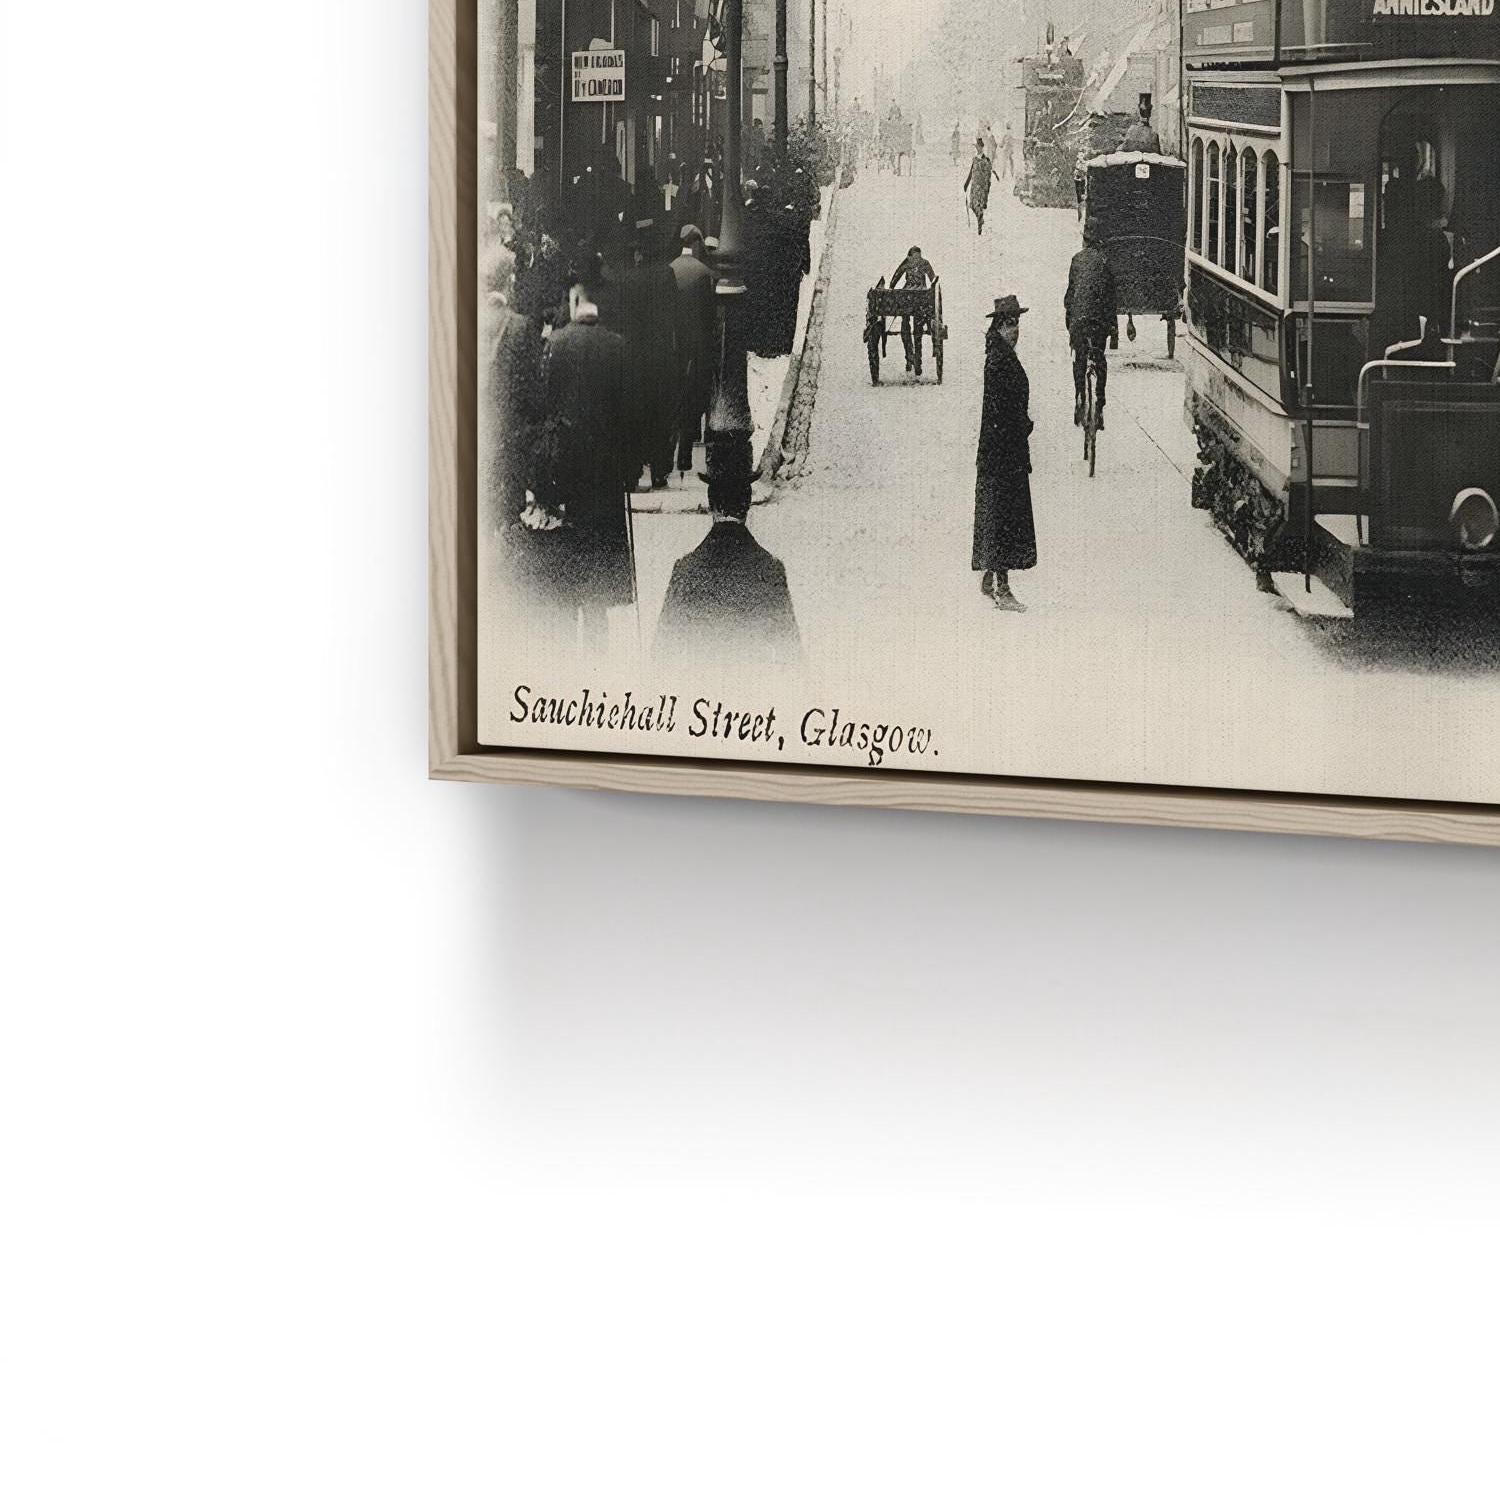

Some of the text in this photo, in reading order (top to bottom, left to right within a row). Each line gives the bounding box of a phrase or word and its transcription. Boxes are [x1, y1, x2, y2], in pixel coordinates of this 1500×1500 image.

[510, 685, 939, 766] Sauchiehall Street, Glasgow.
